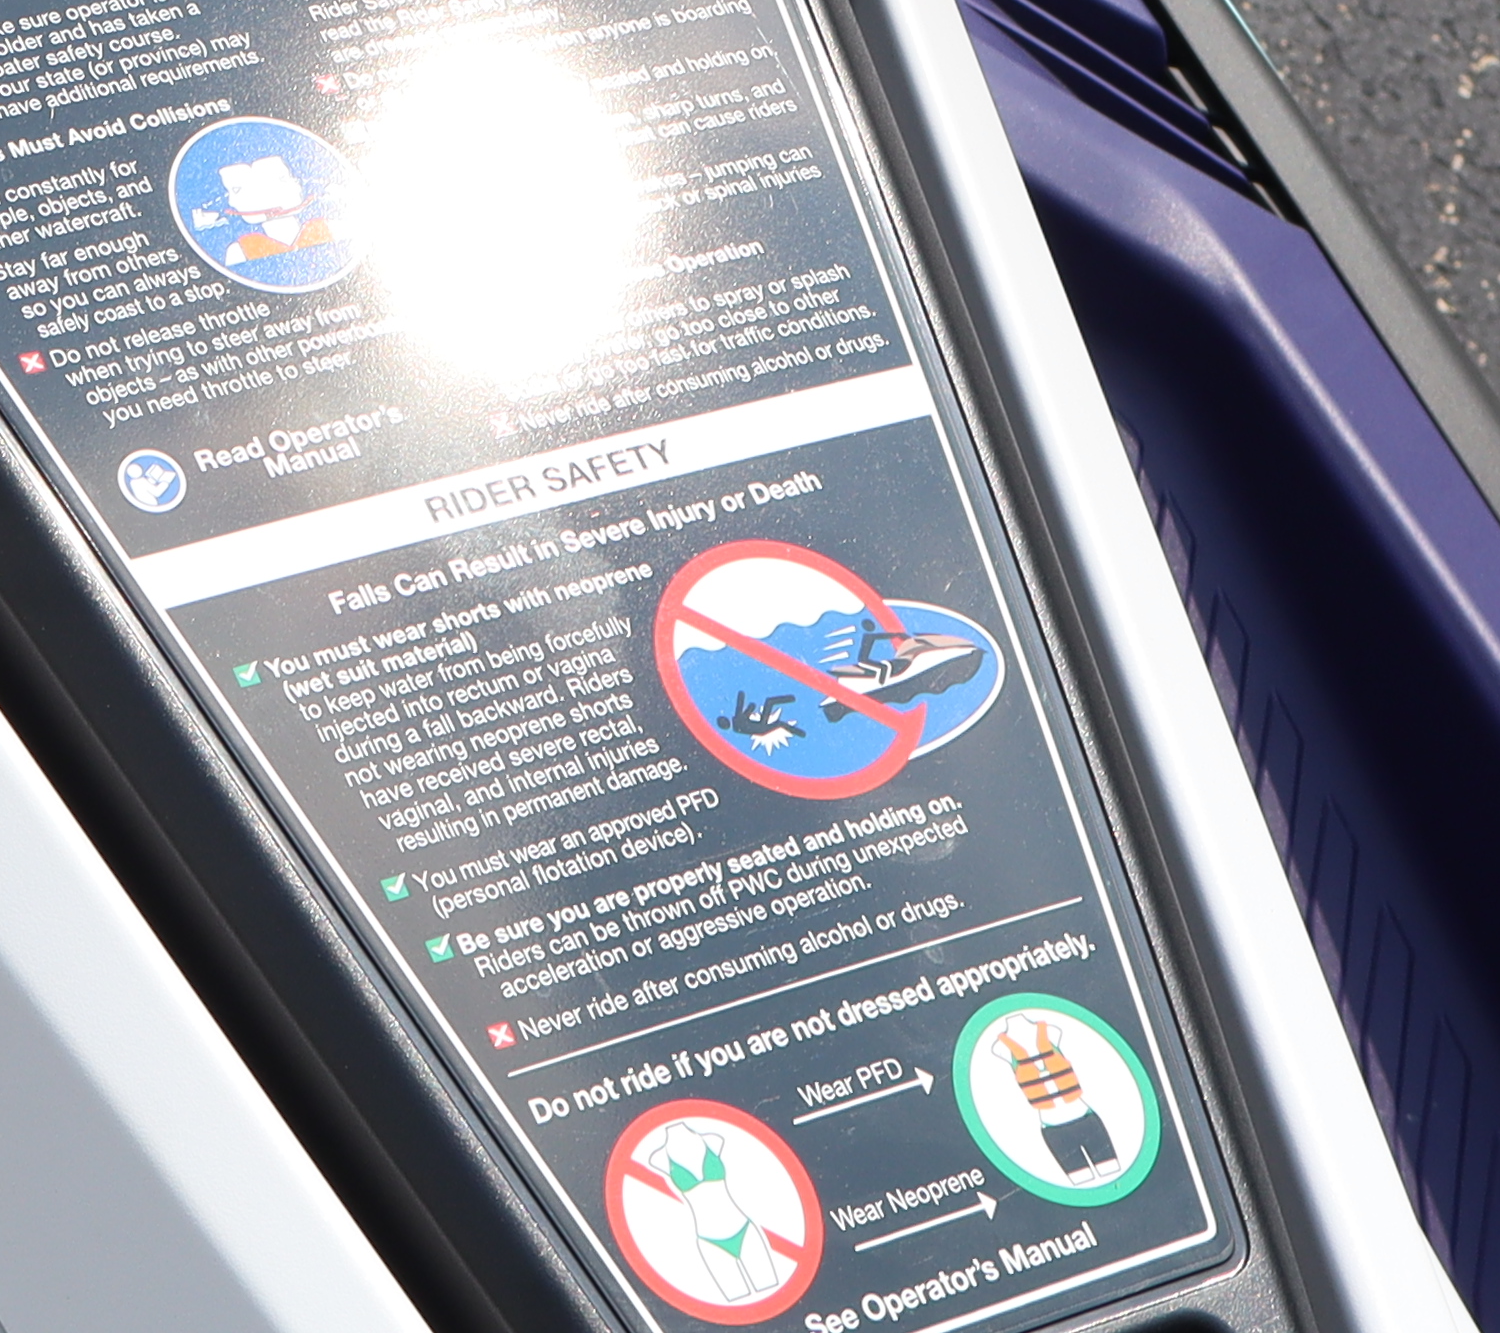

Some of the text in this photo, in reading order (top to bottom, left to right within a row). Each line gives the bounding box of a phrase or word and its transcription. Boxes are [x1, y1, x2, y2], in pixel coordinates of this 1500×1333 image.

[17, 10, 63, 32] sure
[44, 41, 104, 67] safety
[107, 27, 181, 53] course.
[47, 21, 88, 46] and
[86, 17, 127, 37] has
[127, 5, 185, 29] taken
[185, 1, 203, 17] a
[34, 66, 87, 90] state
[87, 59, 115, 82] (or
[117, 37, 209, 76] province)
[208, 31, 251, 53] may
[44, 72, 139, 111] additional
[138, 49, 266, 89] requirements.
[6, 131, 66, 160] Must
[67, 116, 128, 147] Avoid
[128, 97, 232, 132] Collisions
[3, 165, 106, 204] constantly
[108, 159, 138, 180] for
[36, 188, 115, 218] objects,
[114, 174, 155, 200] and
[33, 201, 143, 240] watercraft.
[5, 247, 180, 302] away from others
[39, 249, 69, 271] far
[72, 230, 151, 263] enough
[20, 264, 203, 320] so you can always
[35, 281, 232, 340] safely coast to a stop.
[192, 434, 272, 473] Read
[261, 435, 362, 479] Manual
[424, 438, 669, 523] RIDER SAFETY
[327, 470, 824, 616] Falls Can Result in Severe Injury or Death
[262, 562, 654, 679] You must wear shorts with neoprene
[281, 629, 479, 705] (wet suit material)
[455, 794, 964, 956] Be sure you are properly seated and holding on.
[516, 893, 966, 1042] Never ride after consuming alcohol or drugs.
[526, 931, 1097, 1125] Do not ride if you are not dressed appropriately.
[795, 1057, 904, 1108] Wear PFD
[828, 1167, 986, 1232] Wear Neoprene
[803, 1307, 861, 1333] See
[997, 1220, 1099, 1276] Manual
